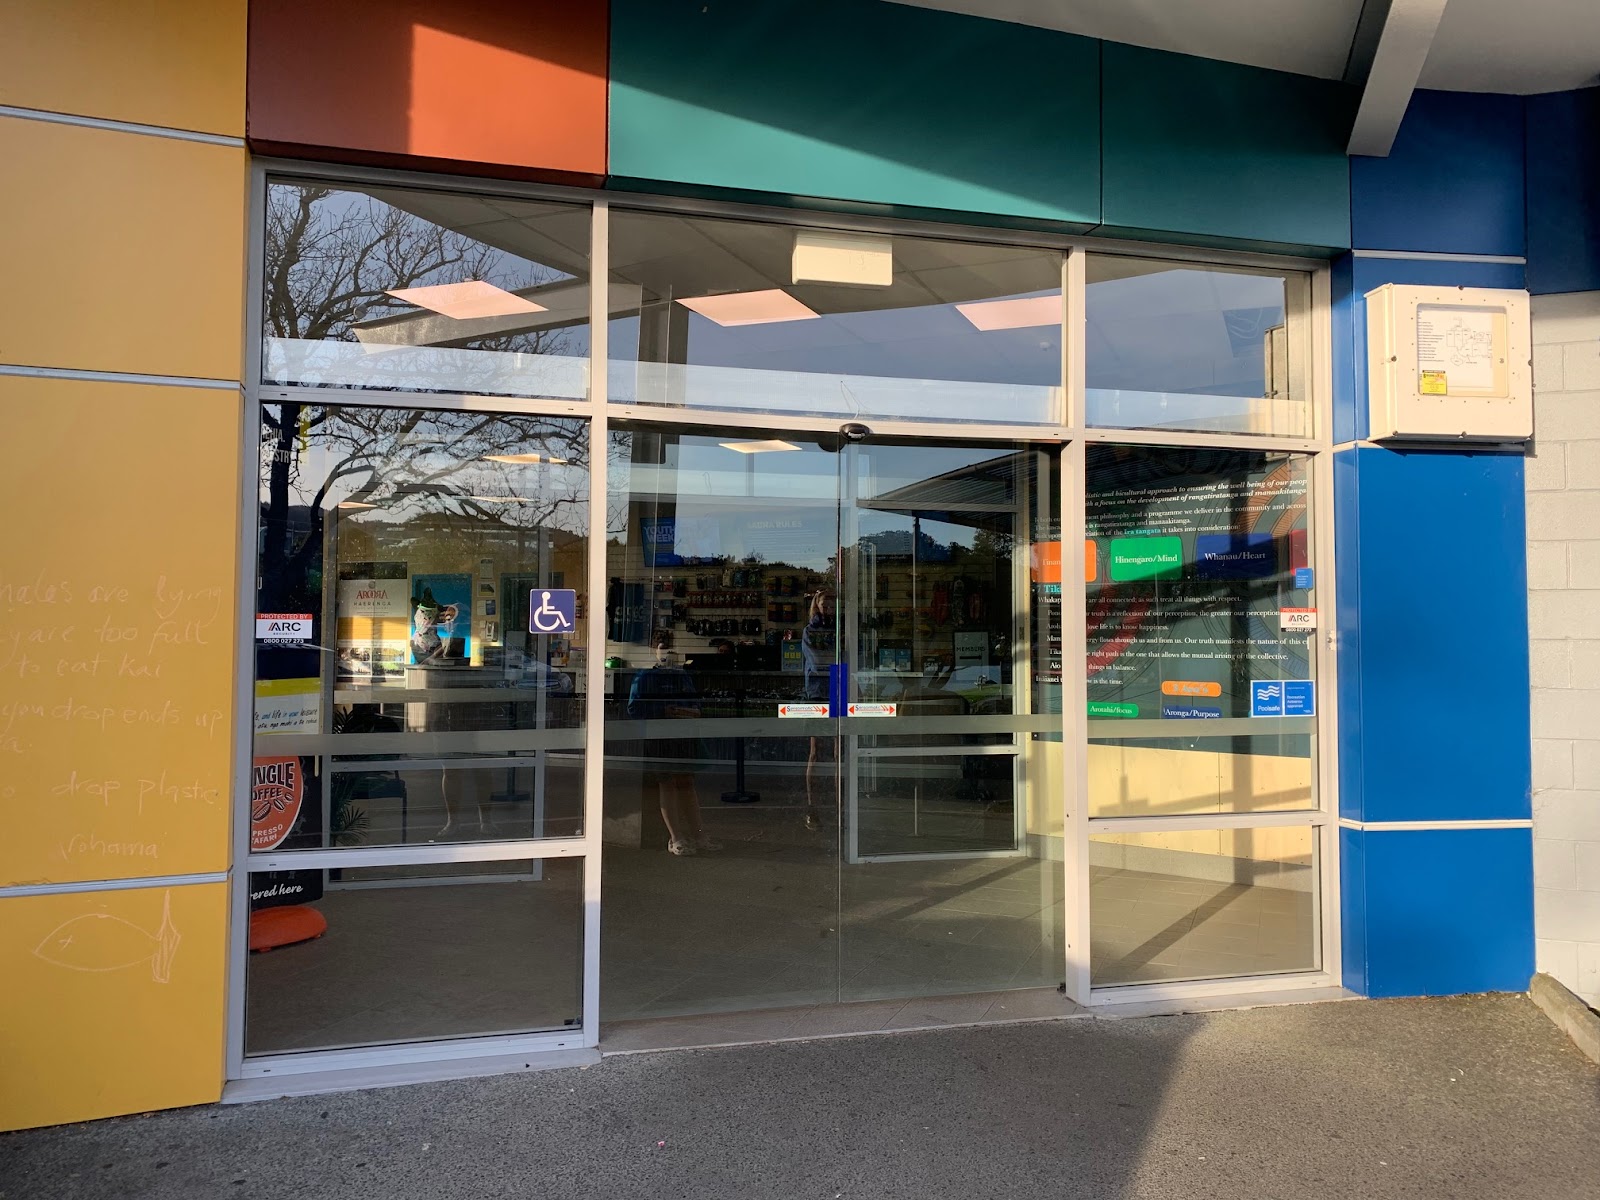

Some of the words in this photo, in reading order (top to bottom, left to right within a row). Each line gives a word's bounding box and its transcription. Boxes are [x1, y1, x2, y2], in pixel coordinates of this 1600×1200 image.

[1116, 488, 1146, 497] bicultural
[1147, 486, 1177, 495] approach
[1187, 484, 1216, 492] ensuring
[1218, 482, 1229, 490] the
[1230, 481, 1245, 489] well
[1247, 481, 1265, 489] being
[1267, 479, 1275, 487] of
[1289, 479, 1307, 487] peop
[1138, 496, 1179, 504] development
[1180, 493, 1189, 502] of
[1148, 510, 1182, 518] programme
[1235, 504, 1271, 512] community
[647, 534, 675, 543] WEEK
[1115, 554, 1178, 565] Hinengaro/Mind
[1184, 595, 1202, 604] things
[1210, 610, 1232, 618] greater
[1288, 614, 1310, 623] ARC
[268, 622, 301, 632] ARC
[1215, 637, 1245, 645] manifests
[1279, 637, 1287, 645] of
[1289, 637, 1301, 645] this
[1214, 652, 1235, 660] arising
[271, 709, 281, 720] life
[253, 762, 295, 792] NGLE
[252, 787, 283, 801] OFFEE
[252, 823, 283, 837] PRESSO
[251, 834, 277, 844] AFARI
[251, 884, 278, 900] ered
[279, 882, 304, 896] here
